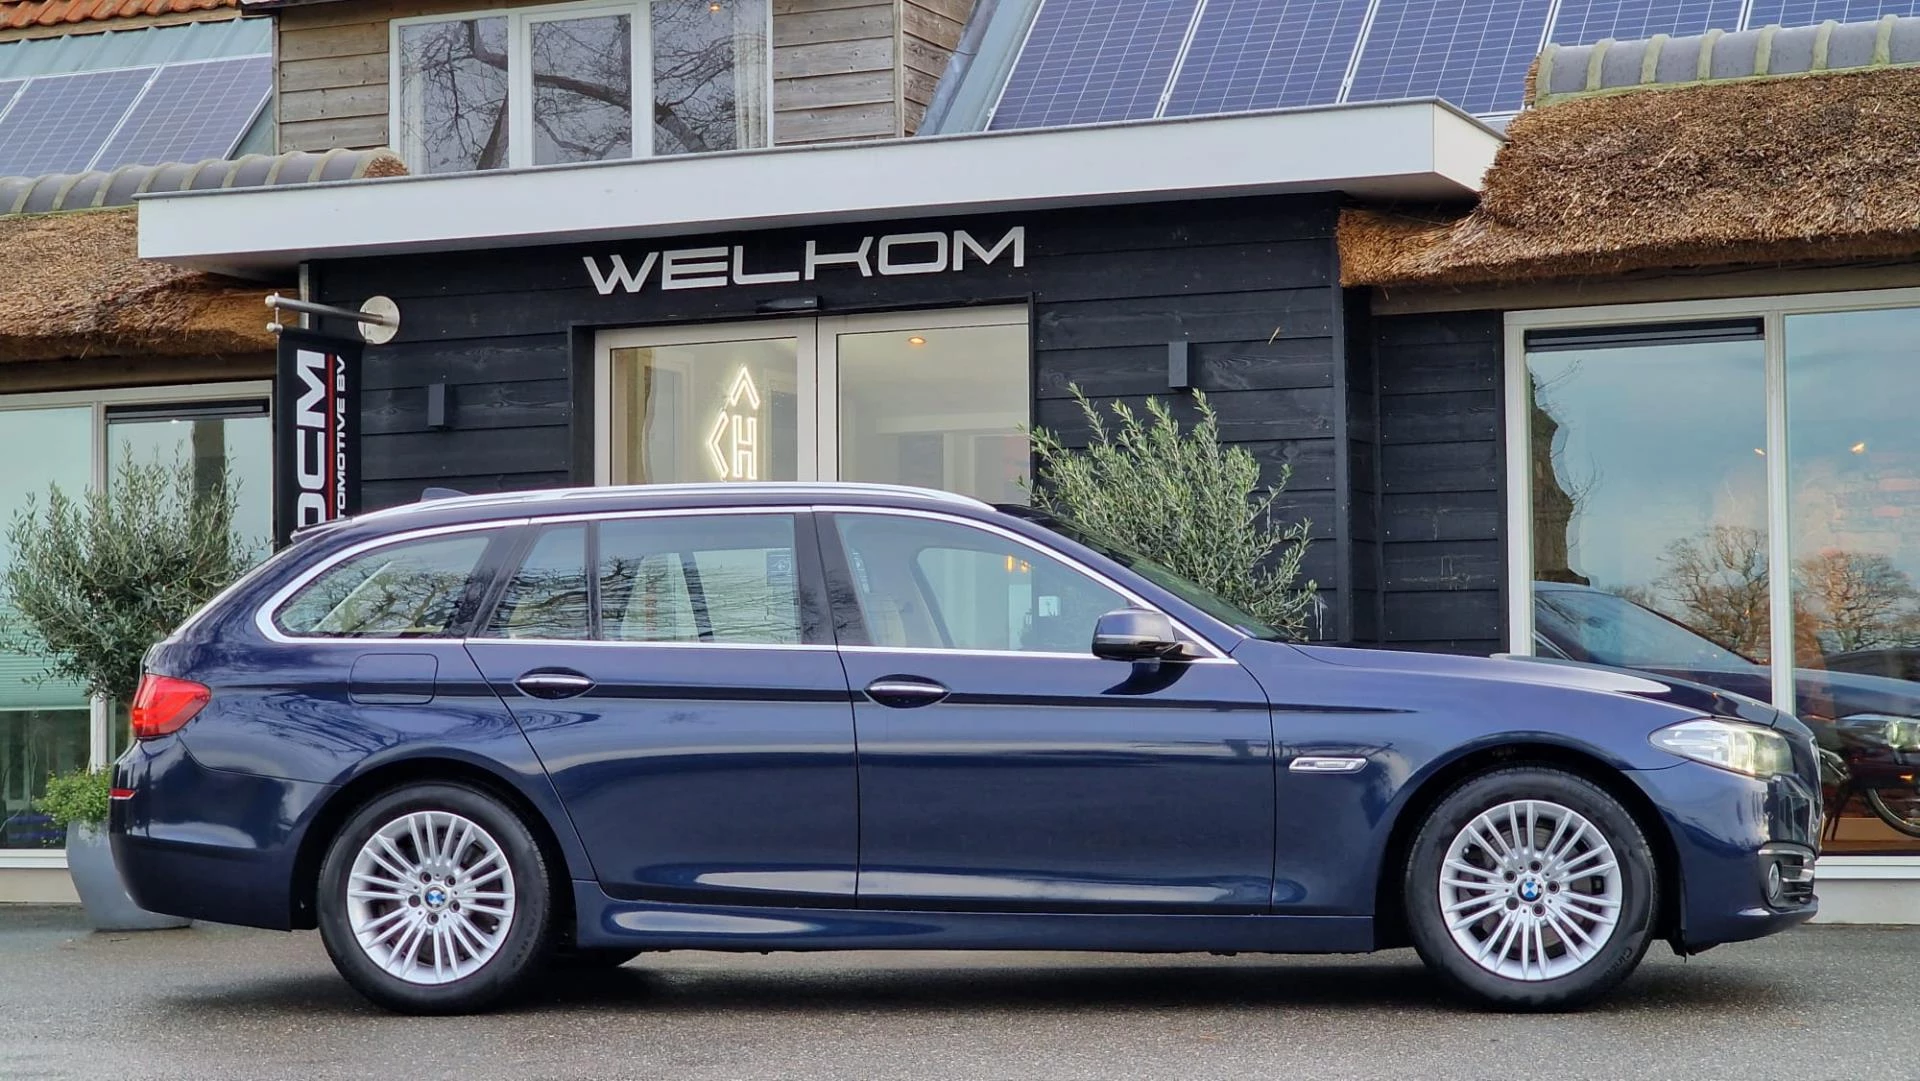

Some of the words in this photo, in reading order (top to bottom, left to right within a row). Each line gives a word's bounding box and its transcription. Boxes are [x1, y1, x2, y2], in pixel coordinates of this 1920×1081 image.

[582, 226, 1025, 295] WELKOM
[336, 354, 346, 392] BV
[336, 398, 346, 519] TOMOTIVE
